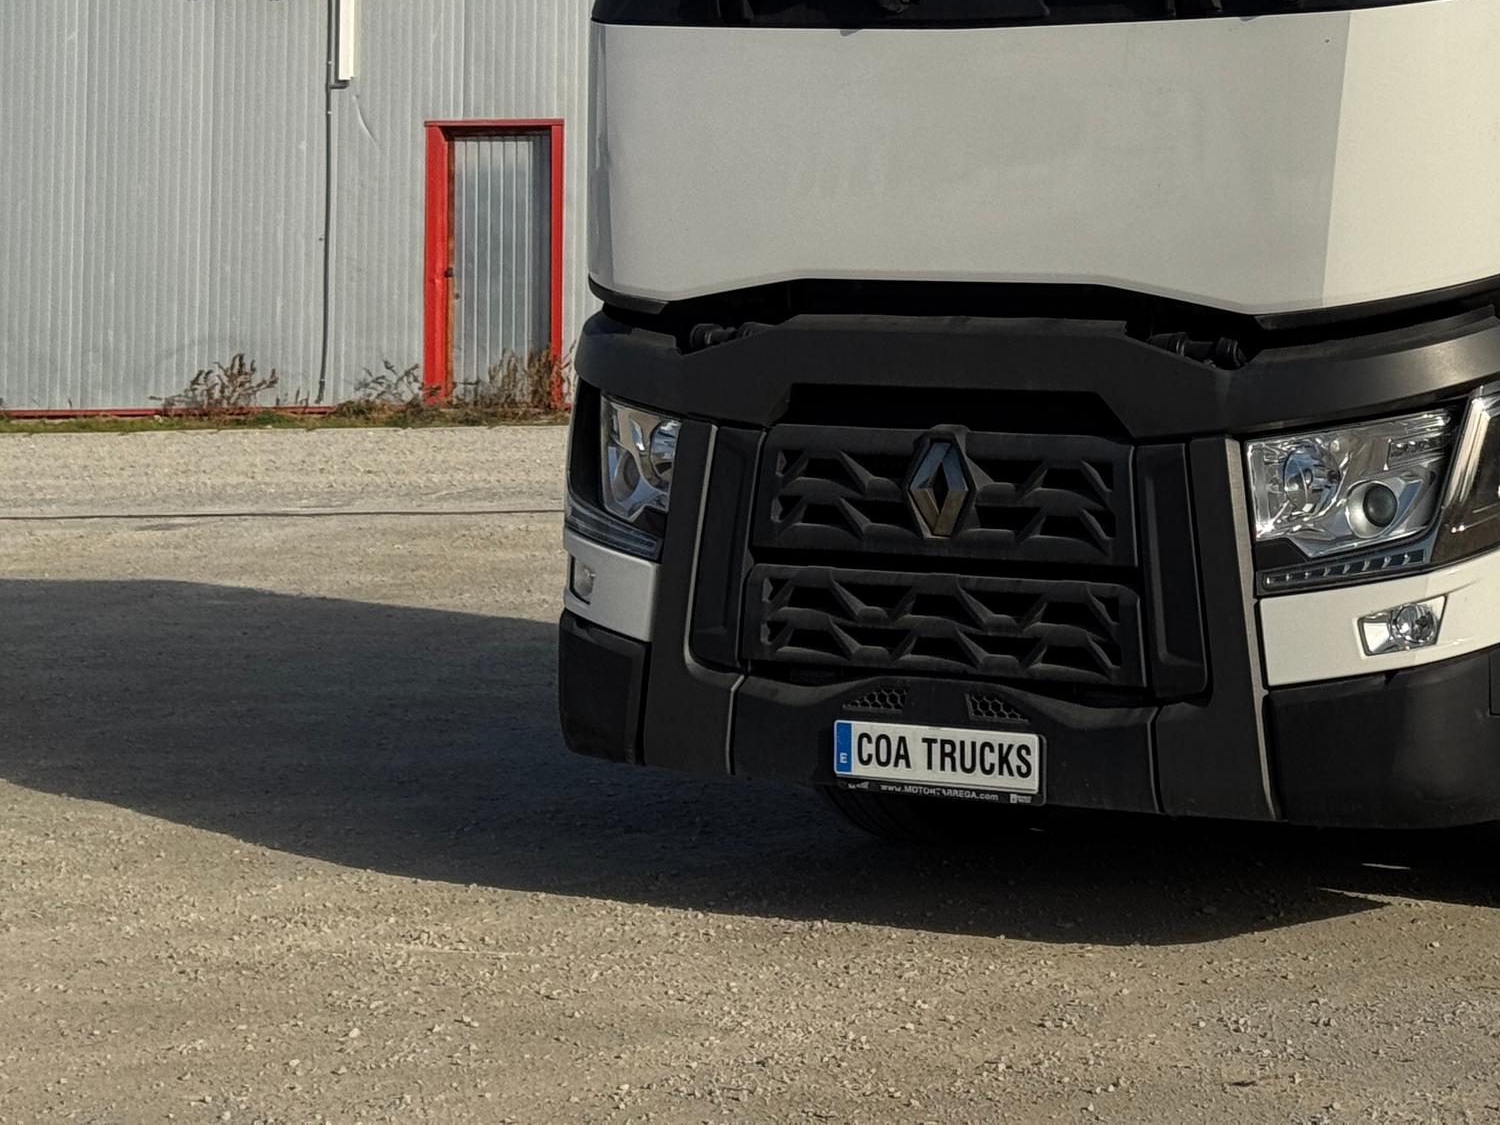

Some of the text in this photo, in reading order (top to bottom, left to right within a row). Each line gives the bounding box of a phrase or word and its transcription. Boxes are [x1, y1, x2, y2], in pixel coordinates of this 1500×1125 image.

[839, 752, 848, 764] E
[857, 732, 1032, 779] COA TRUCKS
